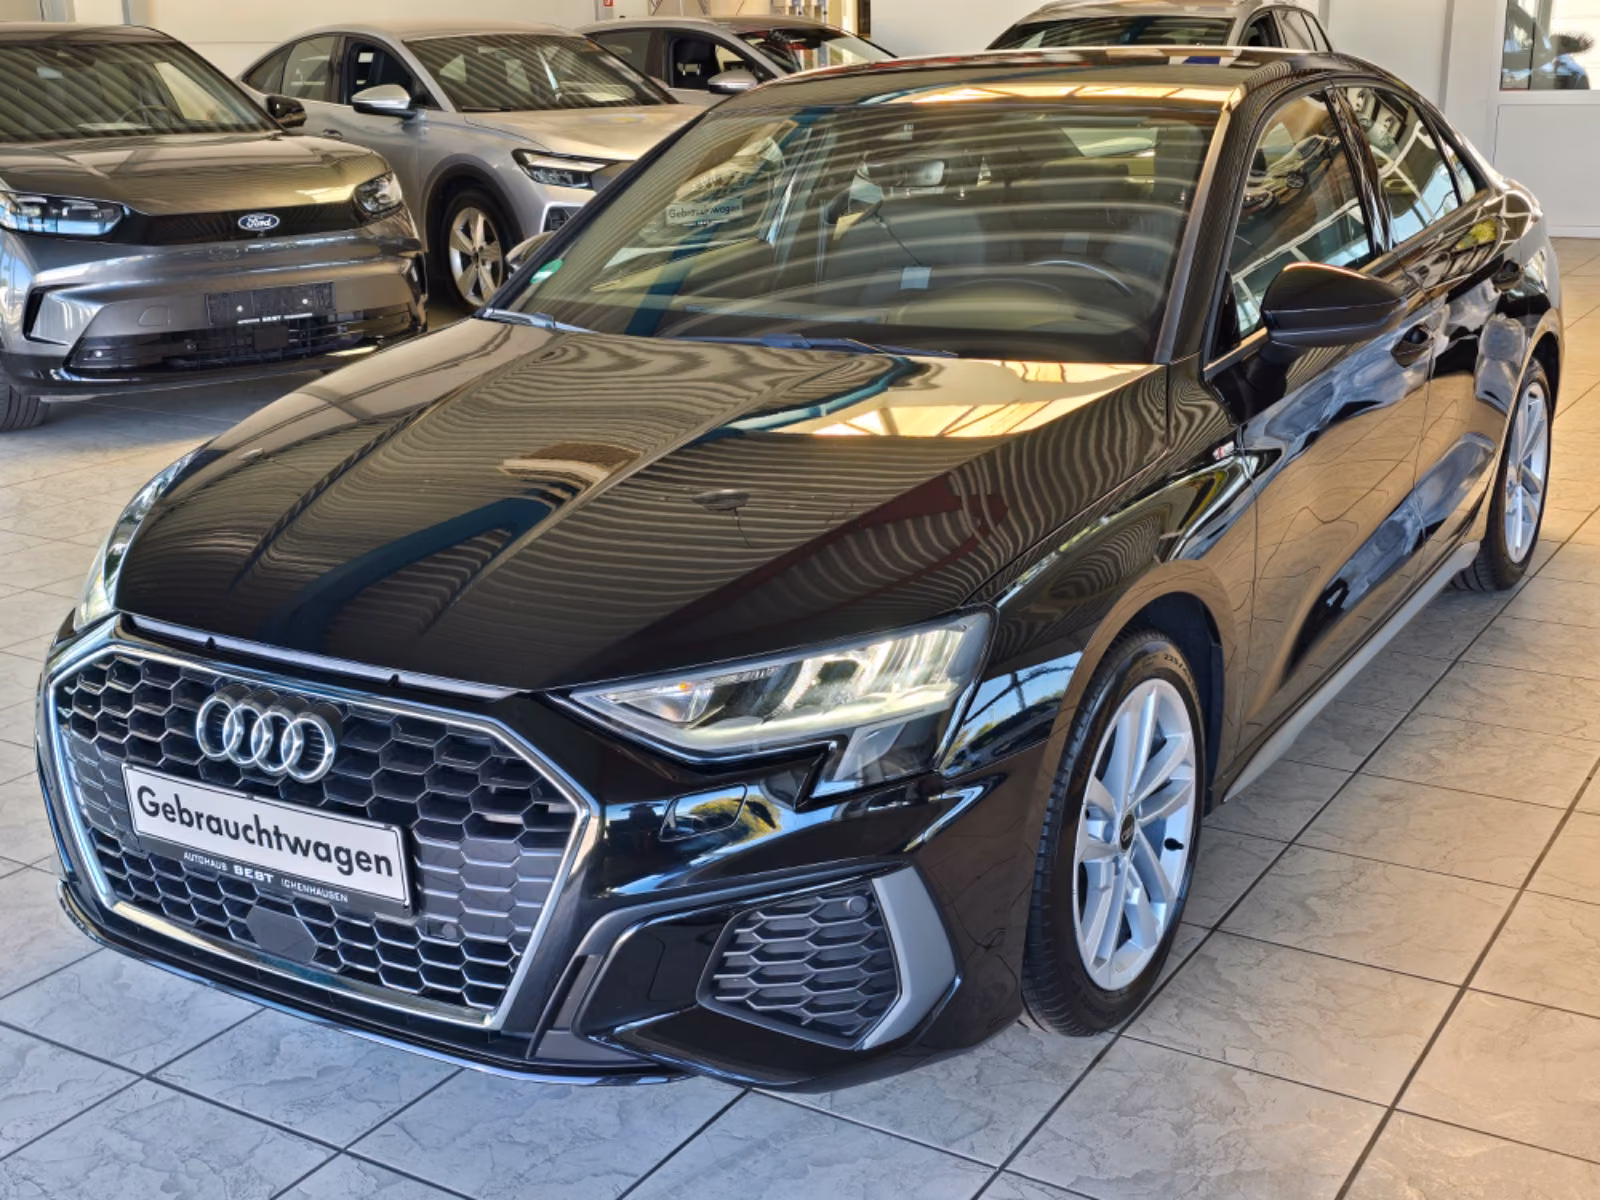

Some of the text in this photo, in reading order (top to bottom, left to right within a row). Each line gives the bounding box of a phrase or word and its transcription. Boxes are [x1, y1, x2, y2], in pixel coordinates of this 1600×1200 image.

[136, 785, 393, 878] Gebrauchtwagen
[183, 851, 348, 904] AUTOHAUS BEST ICHENHAUSEN
